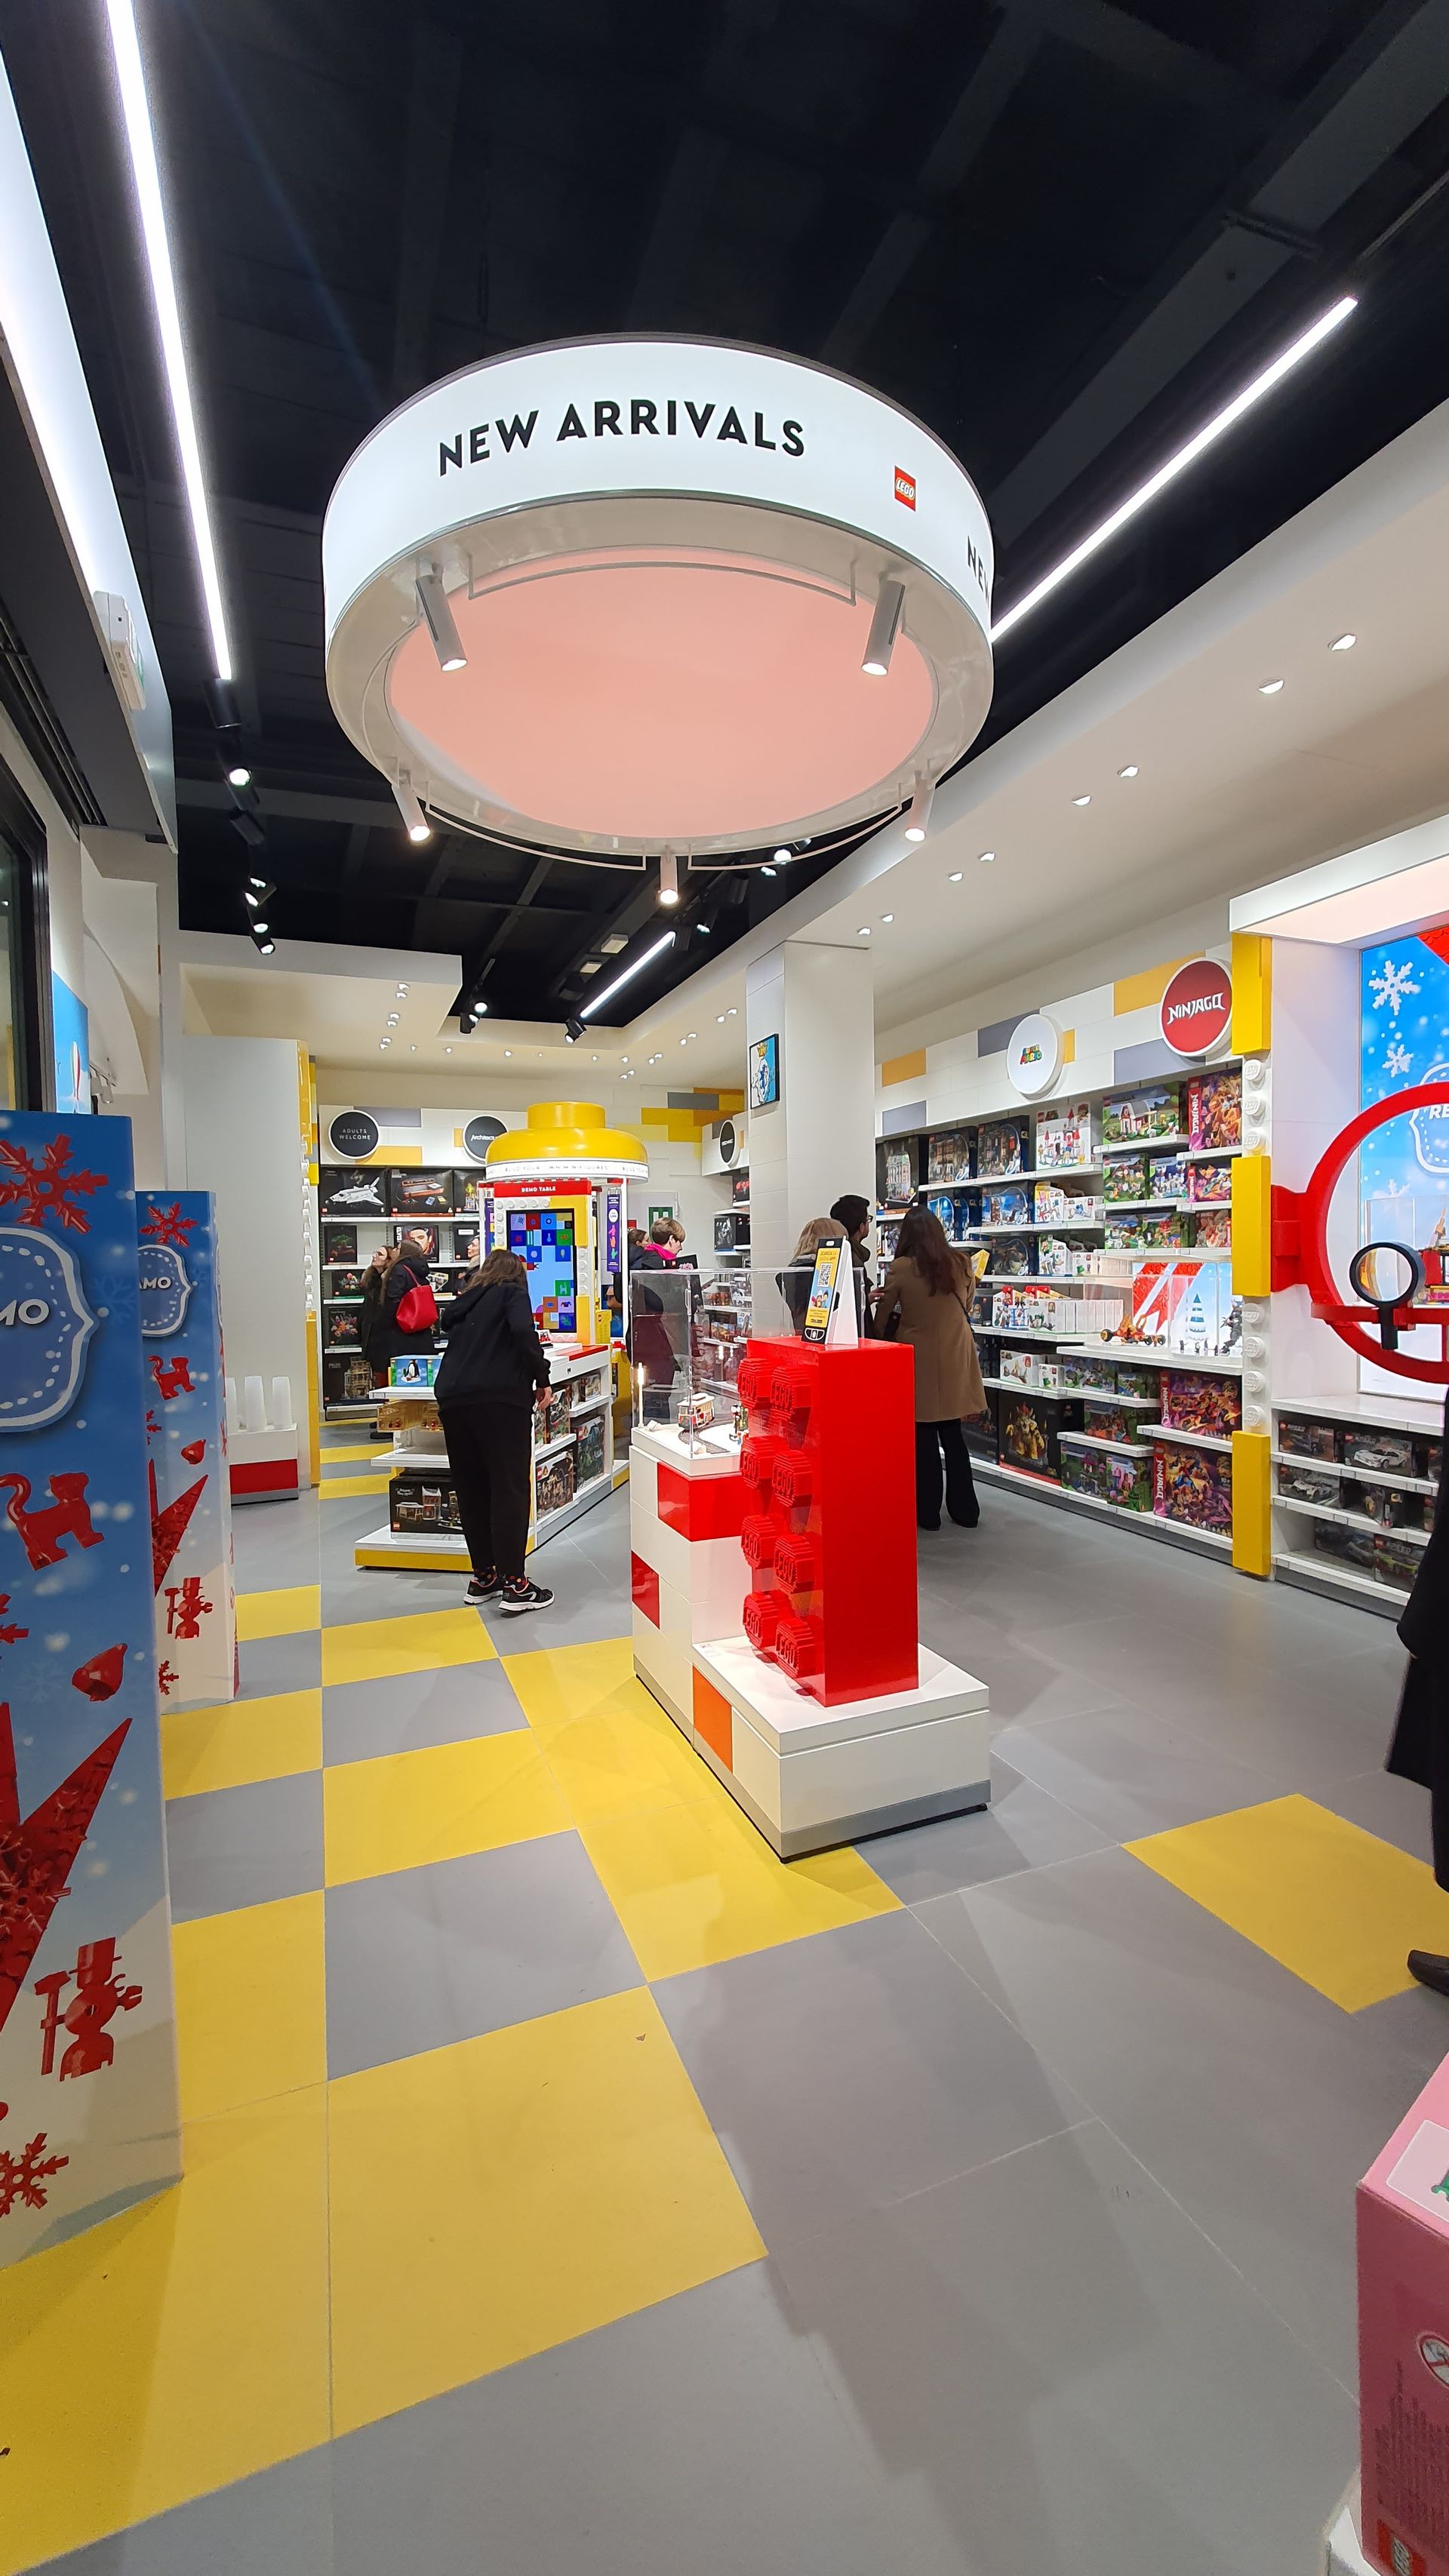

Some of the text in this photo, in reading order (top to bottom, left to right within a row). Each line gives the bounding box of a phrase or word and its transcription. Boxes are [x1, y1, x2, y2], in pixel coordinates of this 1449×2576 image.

[440, 400, 804, 476] NEW ARRIVALS
[896, 478, 915, 500] LEGO
[1167, 993, 1226, 1025] NINJAGO
[1190, 1093, 1199, 1135] NINJAGO
[140, 1276, 171, 1290] MO
[1155, 1459, 1164, 1499] NINJAGO
